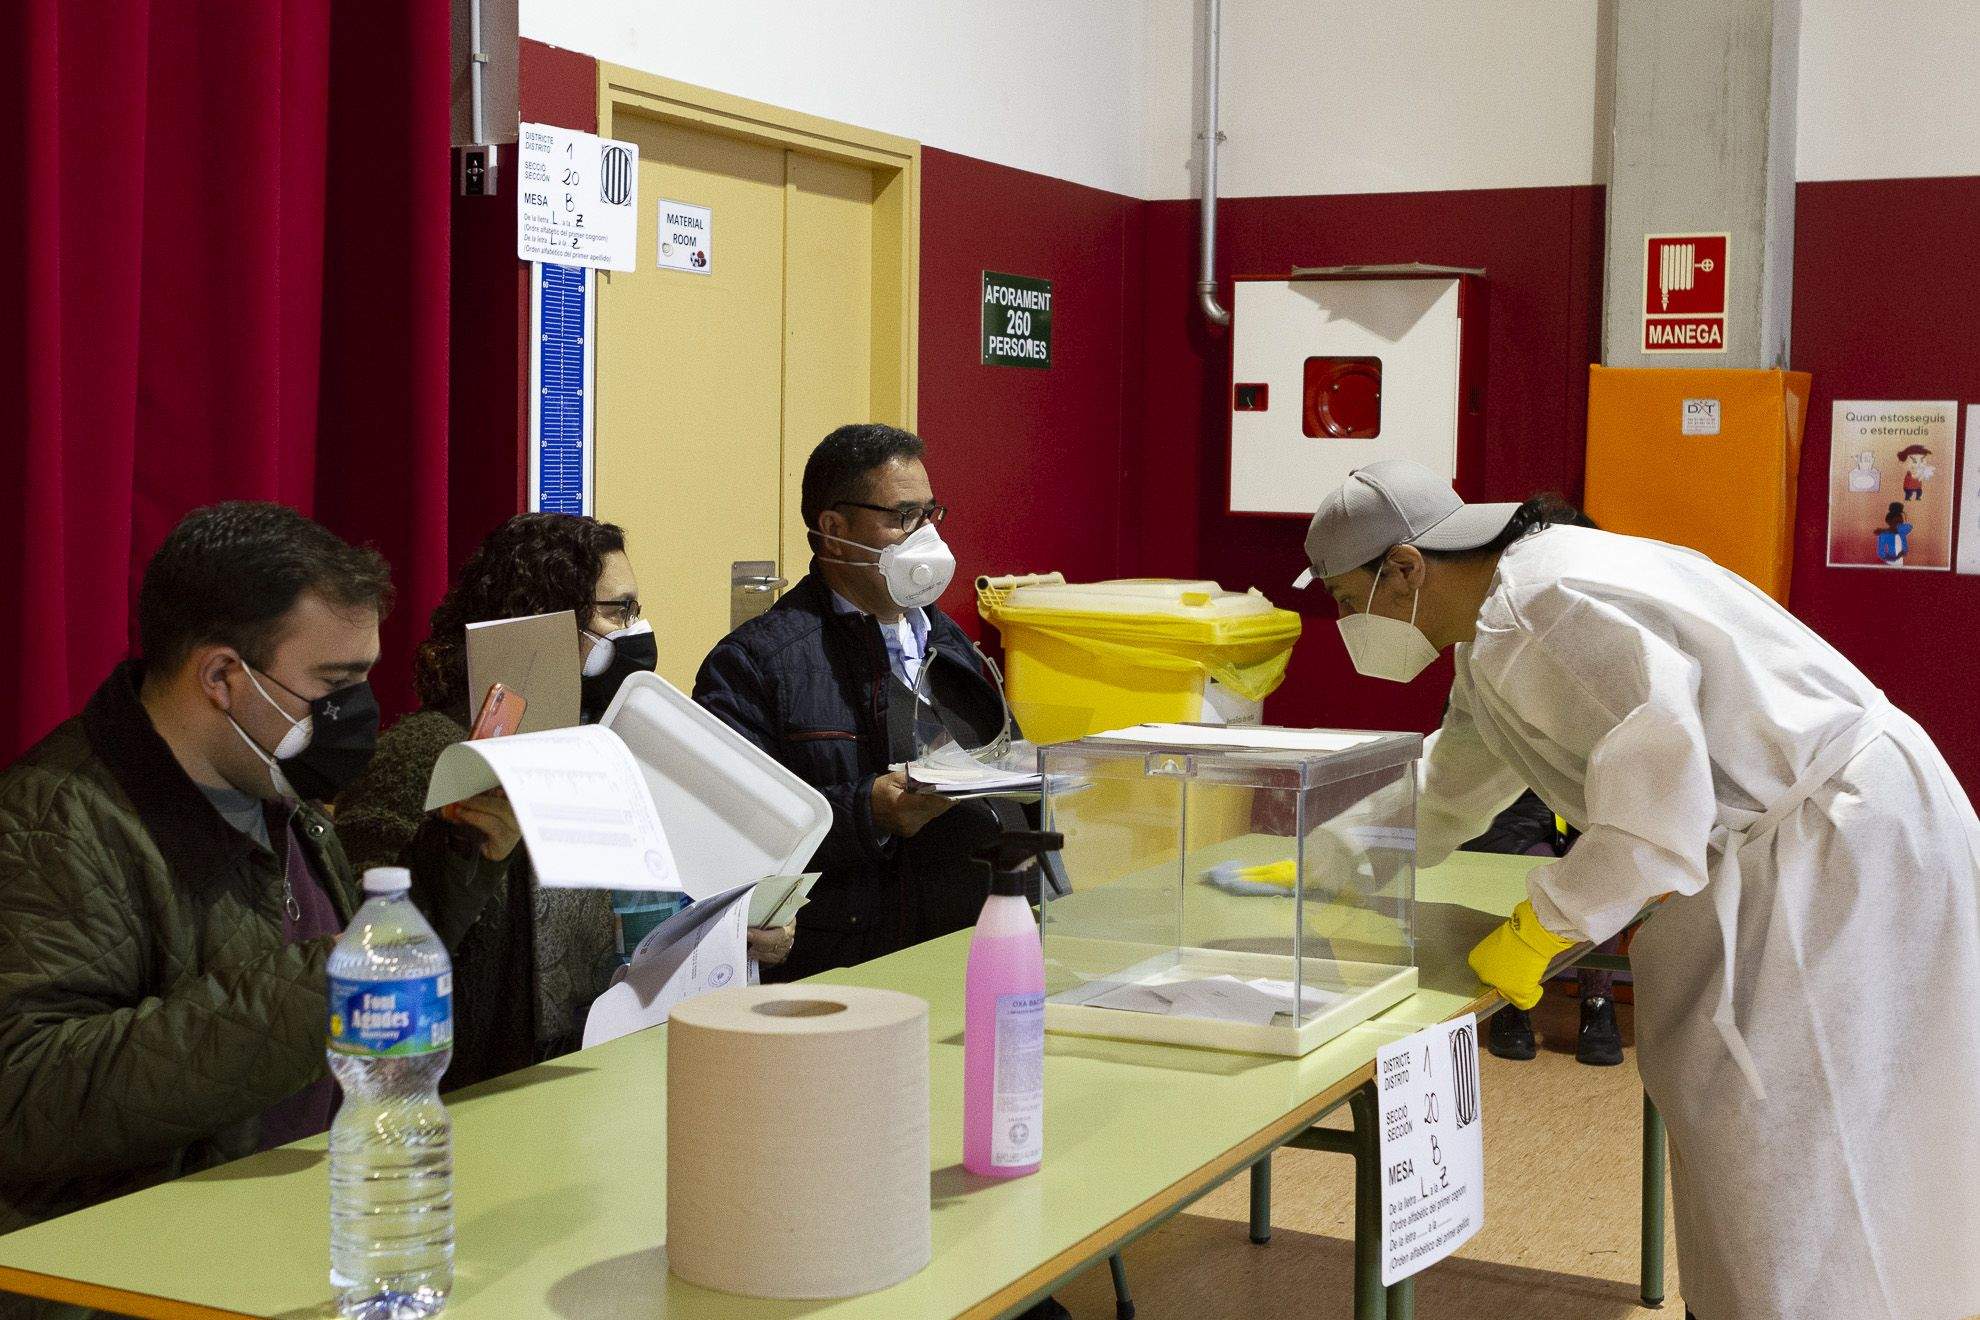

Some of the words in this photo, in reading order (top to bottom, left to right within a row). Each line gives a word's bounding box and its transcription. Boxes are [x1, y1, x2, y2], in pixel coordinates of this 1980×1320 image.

[526, 132, 553, 144] DISTRICTE
[525, 142, 551, 154] DISTRITO
[566, 142, 573, 160] 1
[562, 168, 579, 186] 20
[524, 192, 548, 206] MESA
[566, 193, 574, 212] B
[667, 213, 703, 230] MATERIAL
[673, 234, 696, 246] ROOM
[985, 285, 1052, 311] AFORAMENT
[1007, 310, 1031, 336] 260
[577, 337, 583, 345] 50
[1649, 324, 1721, 344] MANEGA
[989, 335, 1047, 360] PERSONES
[1846, 412, 1877, 422] Quan
[1880, 412, 1946, 425] estosseguis
[1871, 426, 1929, 436] esternudis
[1383, 1051, 1411, 1073] DISTRICTE
[1424, 1044, 1432, 1078] 1
[1384, 1069, 1409, 1091] DISTRITO
[1424, 1092, 1439, 1124] 20
[1431, 1135, 1442, 1165] B
[1388, 1159, 1415, 1186] MESA
[1390, 1203, 1397, 1216] De
[1390, 1239, 1397, 1252] De
